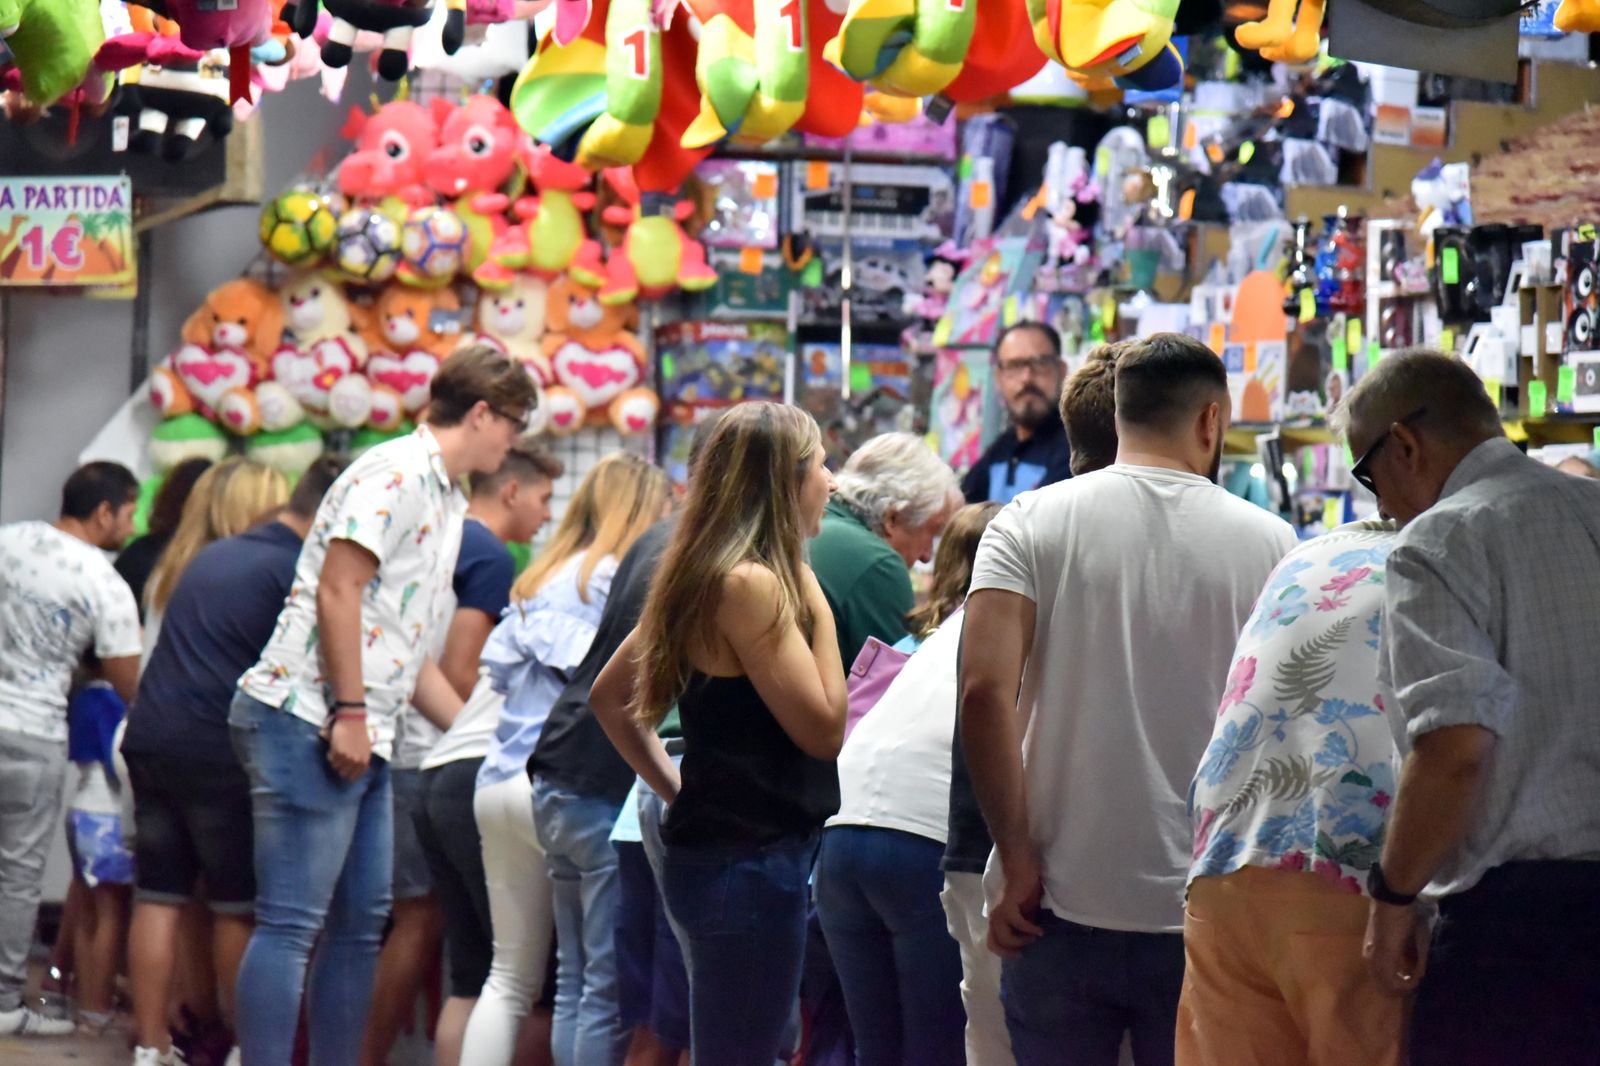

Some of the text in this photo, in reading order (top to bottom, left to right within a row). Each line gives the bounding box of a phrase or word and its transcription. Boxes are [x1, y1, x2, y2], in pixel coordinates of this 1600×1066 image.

[780, 0, 801, 48] 1
[623, 30, 648, 78] 1
[23, 185, 124, 209] PARTIDA
[21, 226, 81, 266] 1€
